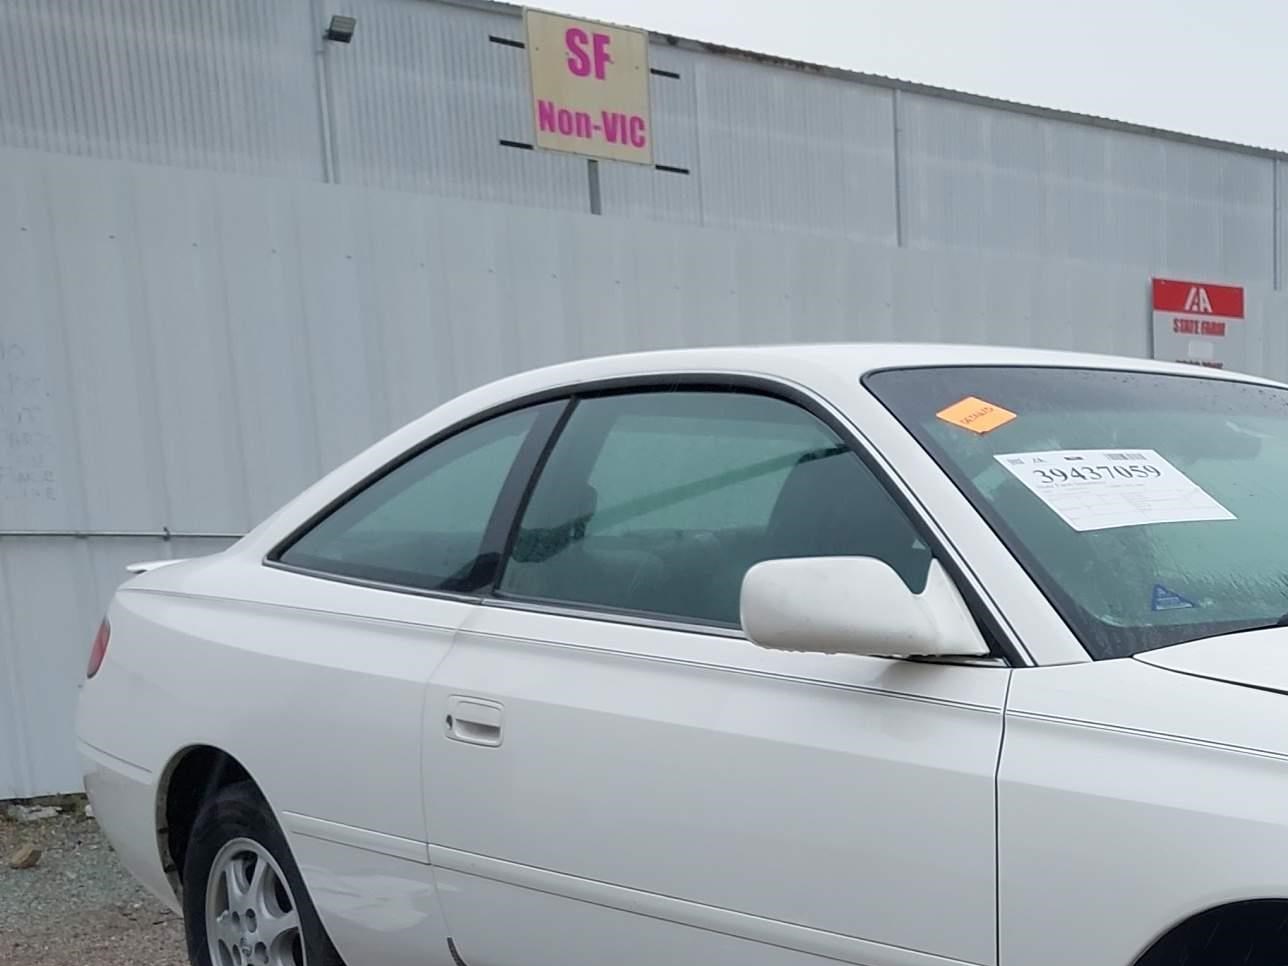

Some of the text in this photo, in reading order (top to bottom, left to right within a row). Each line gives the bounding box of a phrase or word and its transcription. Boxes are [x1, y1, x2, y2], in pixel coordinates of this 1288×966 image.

[565, 27, 614, 80] SF
[537, 100, 646, 148] Non-VIC
[1033, 464, 1162, 484] 39437059
